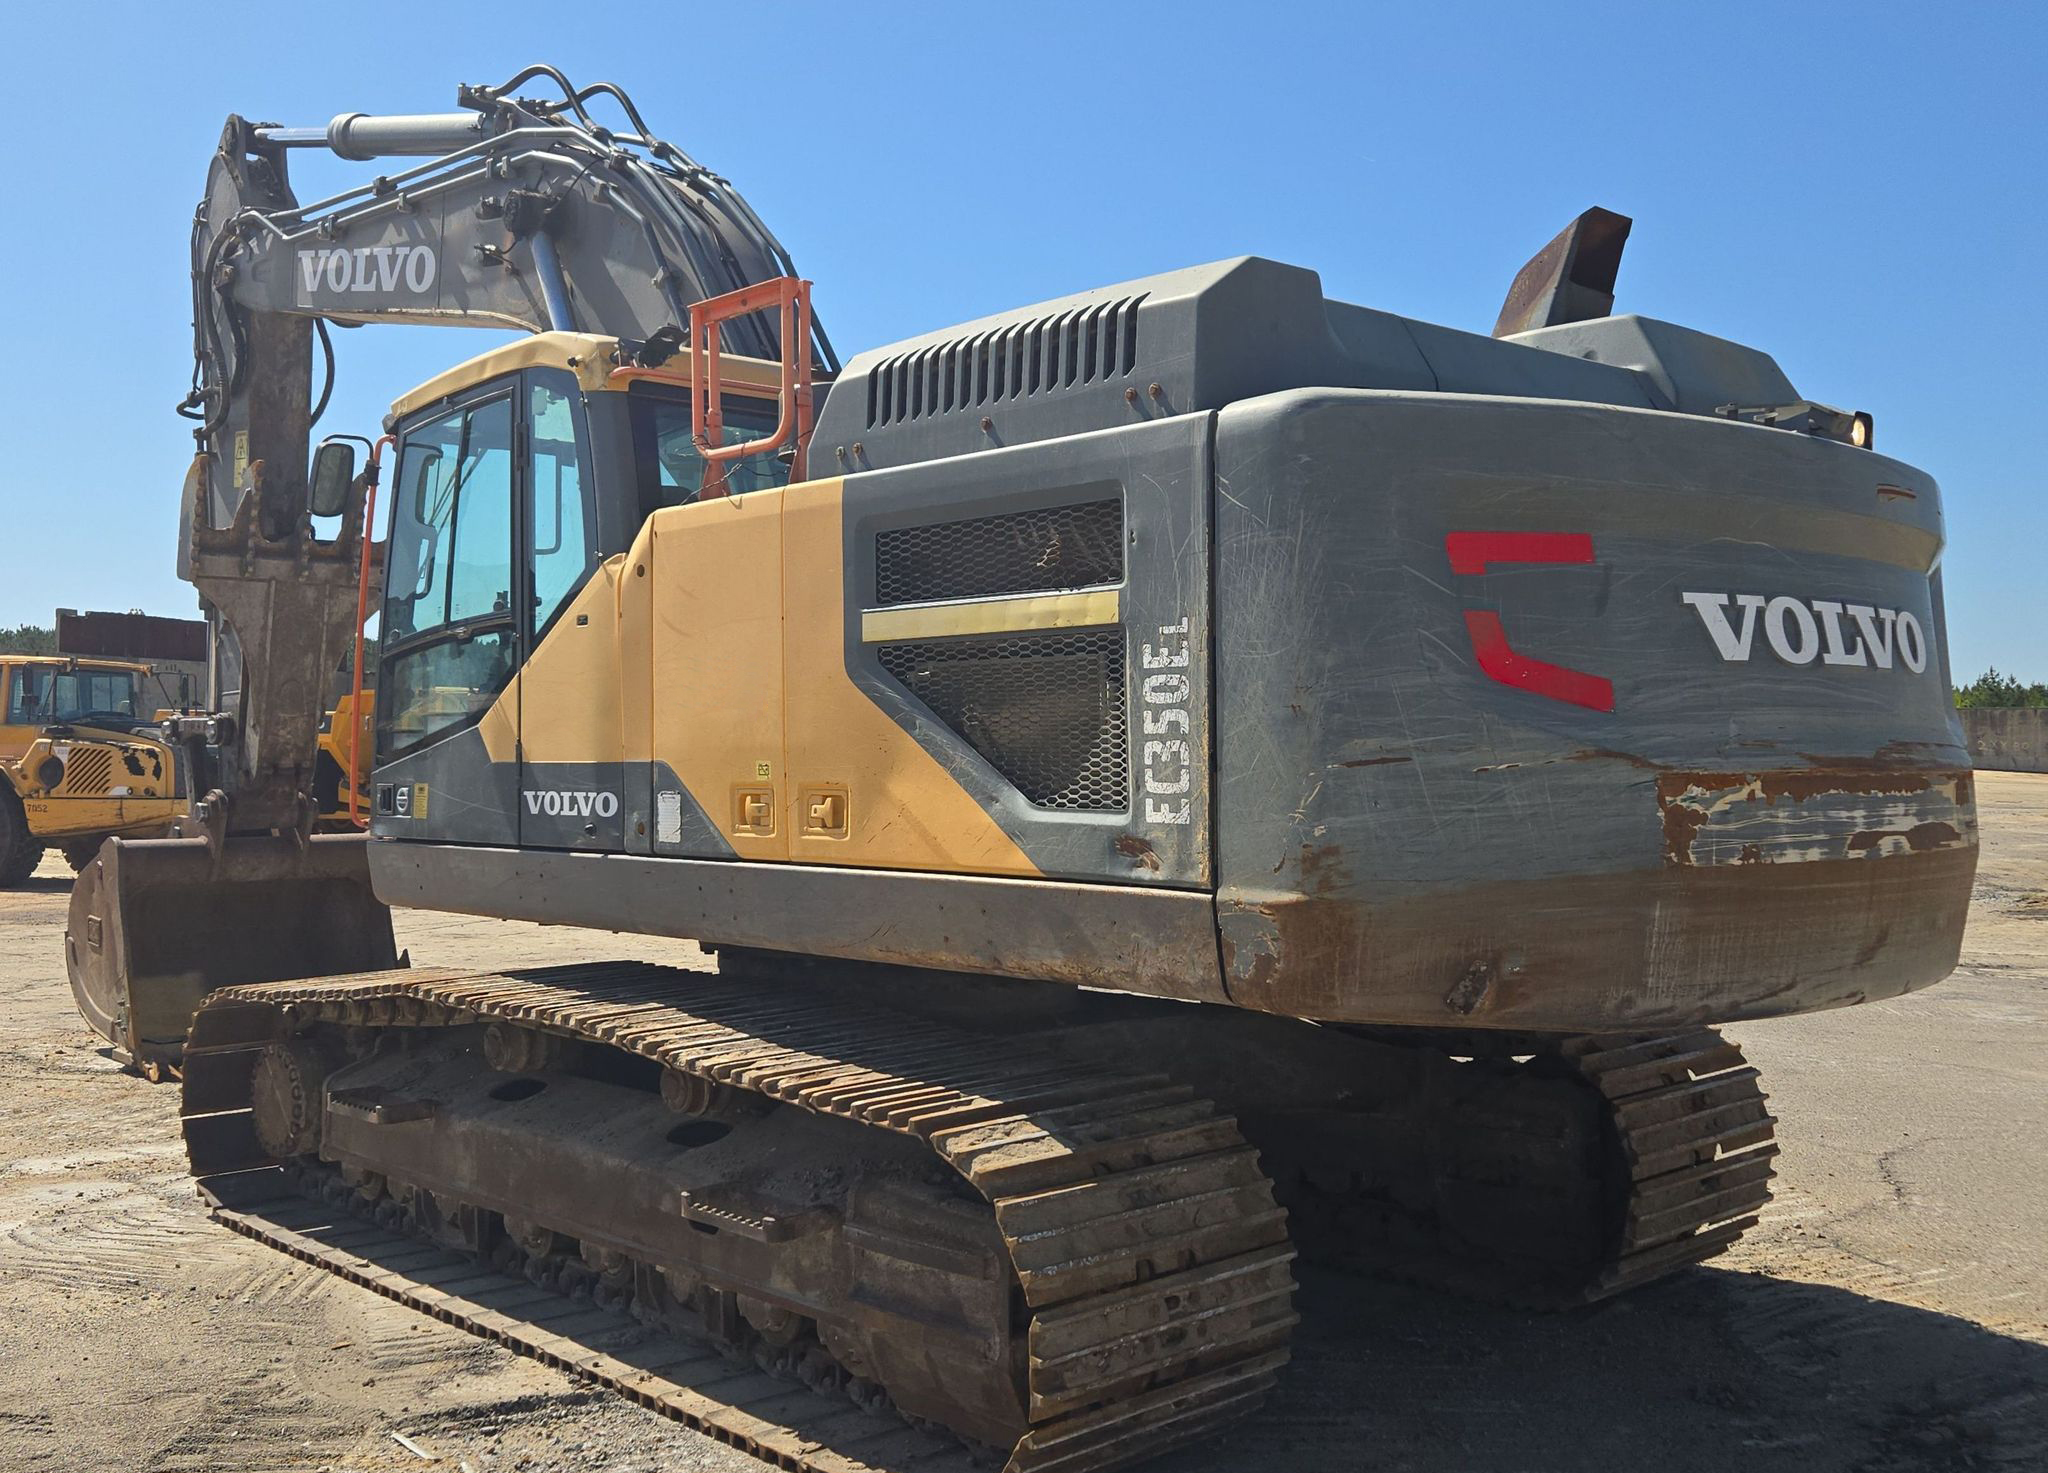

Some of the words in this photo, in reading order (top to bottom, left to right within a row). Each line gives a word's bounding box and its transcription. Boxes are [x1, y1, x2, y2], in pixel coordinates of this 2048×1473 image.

[298, 246, 436, 293] VOLVO
[1682, 592, 1927, 674] VOLVO
[1143, 617, 1190, 824] EC350EL
[523, 791, 618, 818] VOLVO
